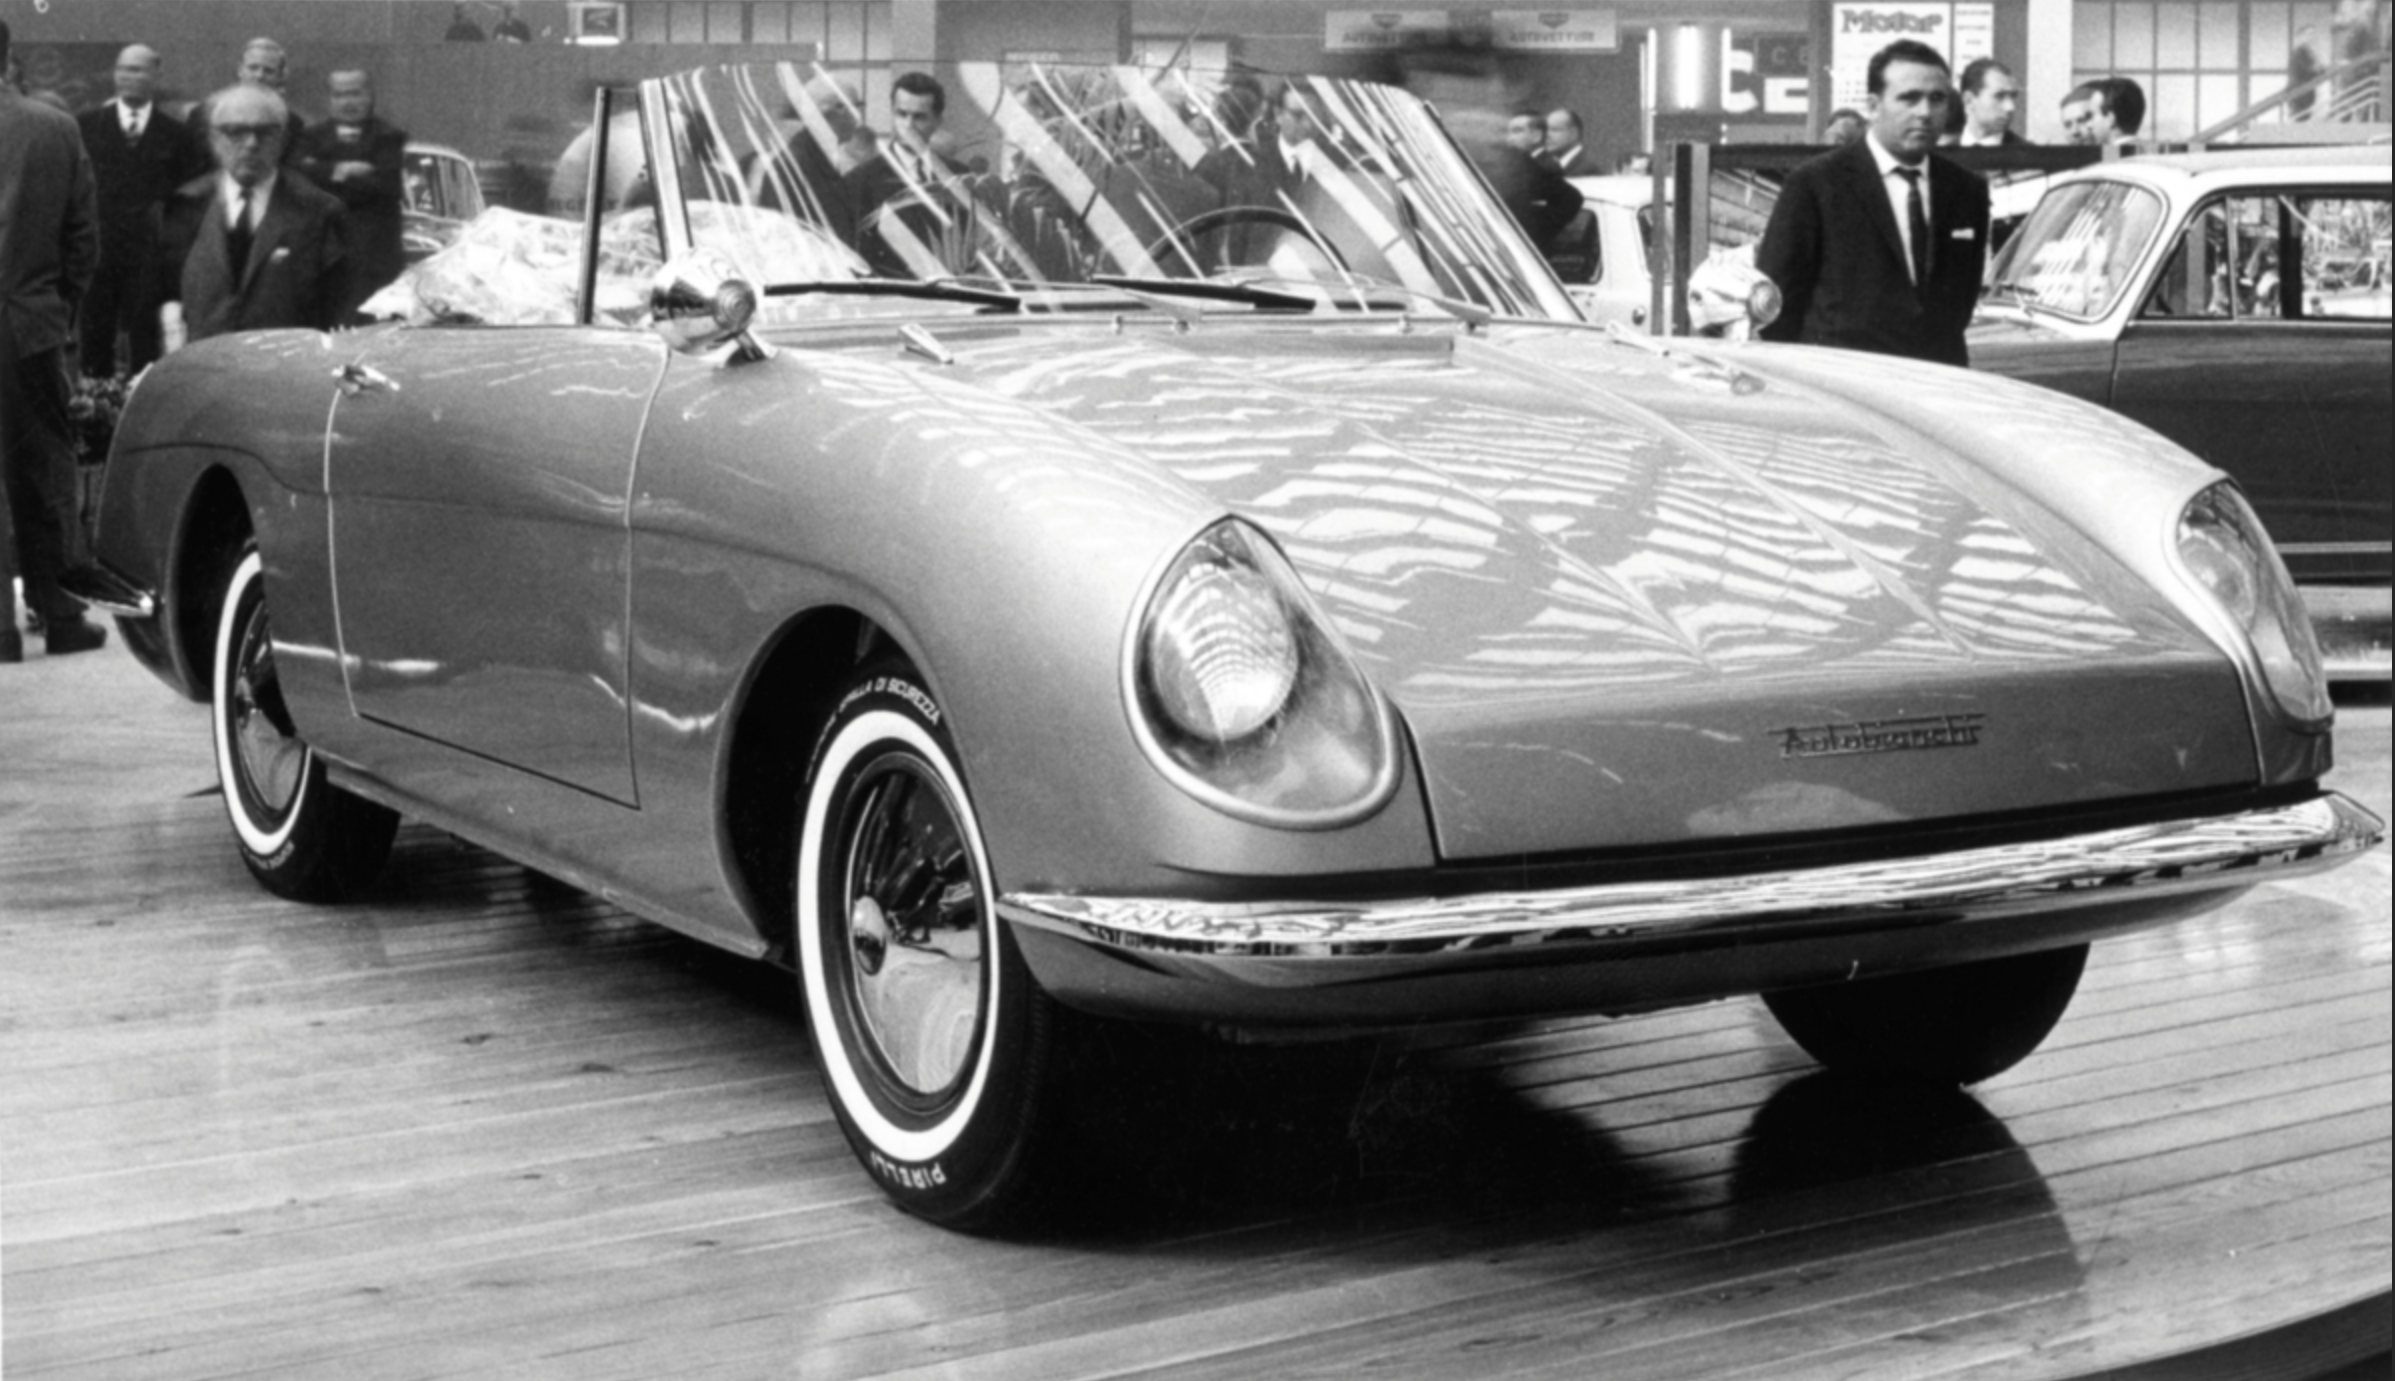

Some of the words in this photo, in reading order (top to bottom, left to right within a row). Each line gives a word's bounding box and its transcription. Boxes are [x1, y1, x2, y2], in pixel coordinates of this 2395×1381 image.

[1840, 9, 1943, 34] Motor
[1769, 714, 1985, 758] Autobianchi
[870, 1151, 948, 1189] PIRELLI
